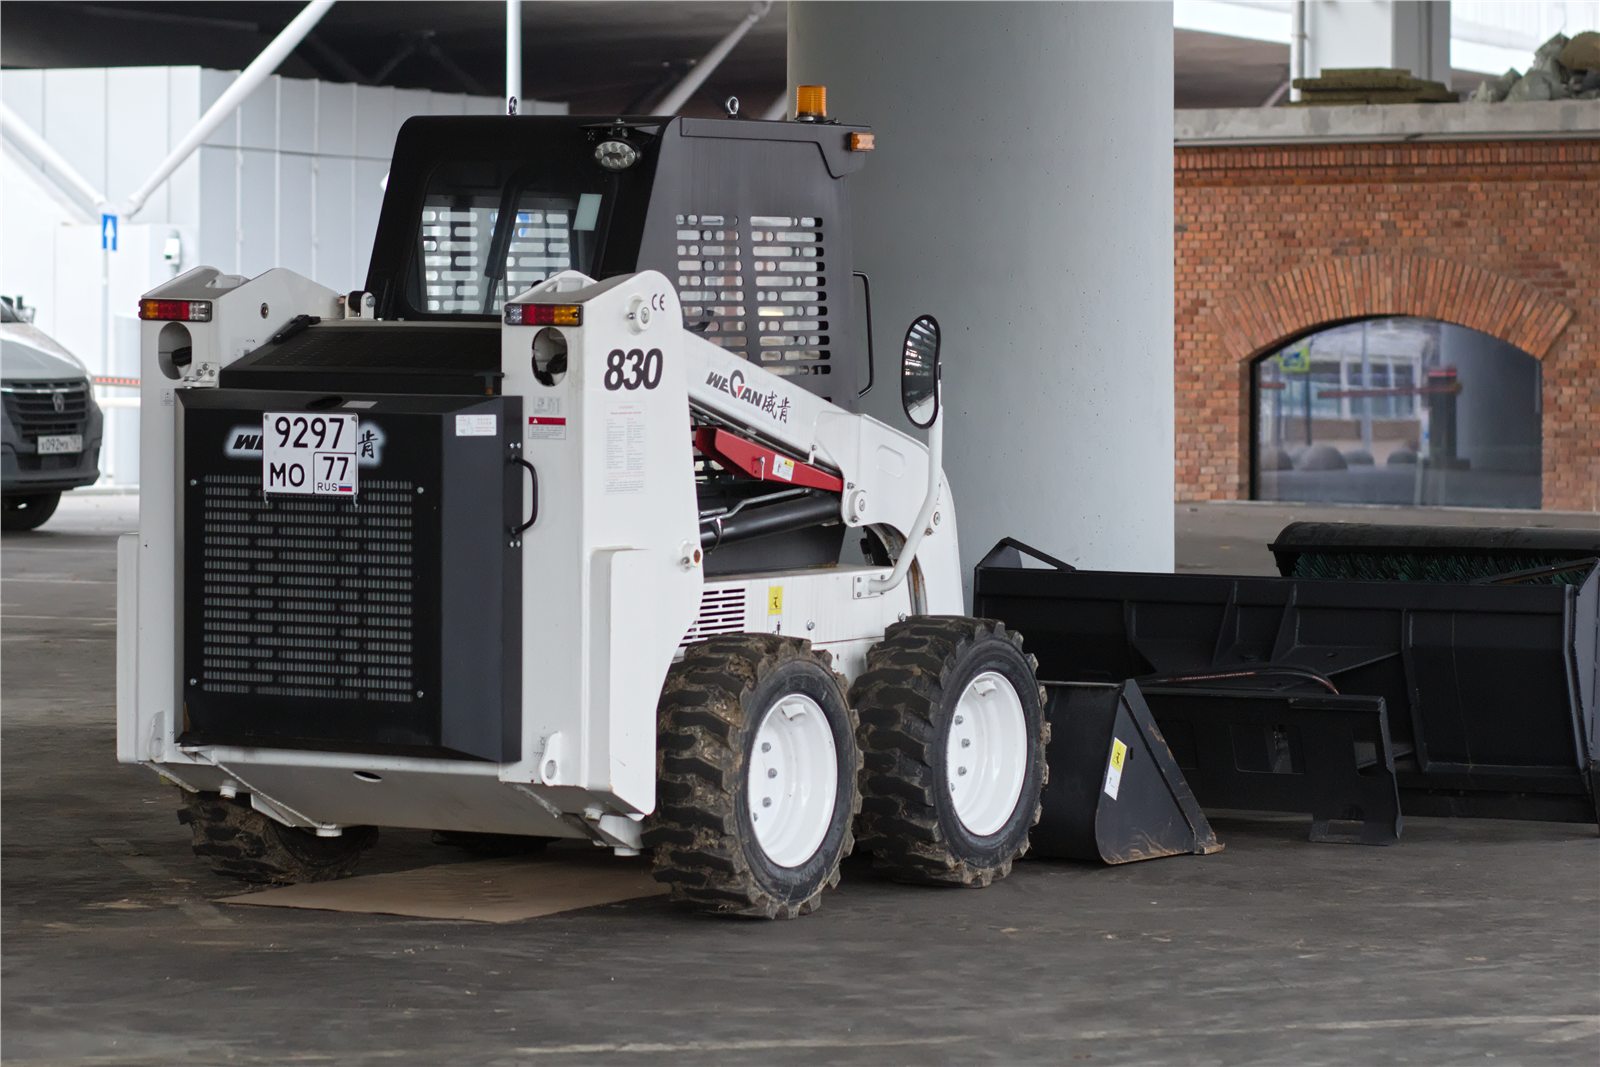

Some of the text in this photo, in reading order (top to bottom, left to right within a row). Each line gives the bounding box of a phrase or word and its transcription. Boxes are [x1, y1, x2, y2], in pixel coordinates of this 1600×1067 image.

[652, 294, 665, 311] CE
[604, 348, 663, 391] 830
[275, 416, 345, 449] 9297
[269, 462, 305, 487] MO
[323, 456, 349, 481] 77
[317, 483, 338, 491] RUS
